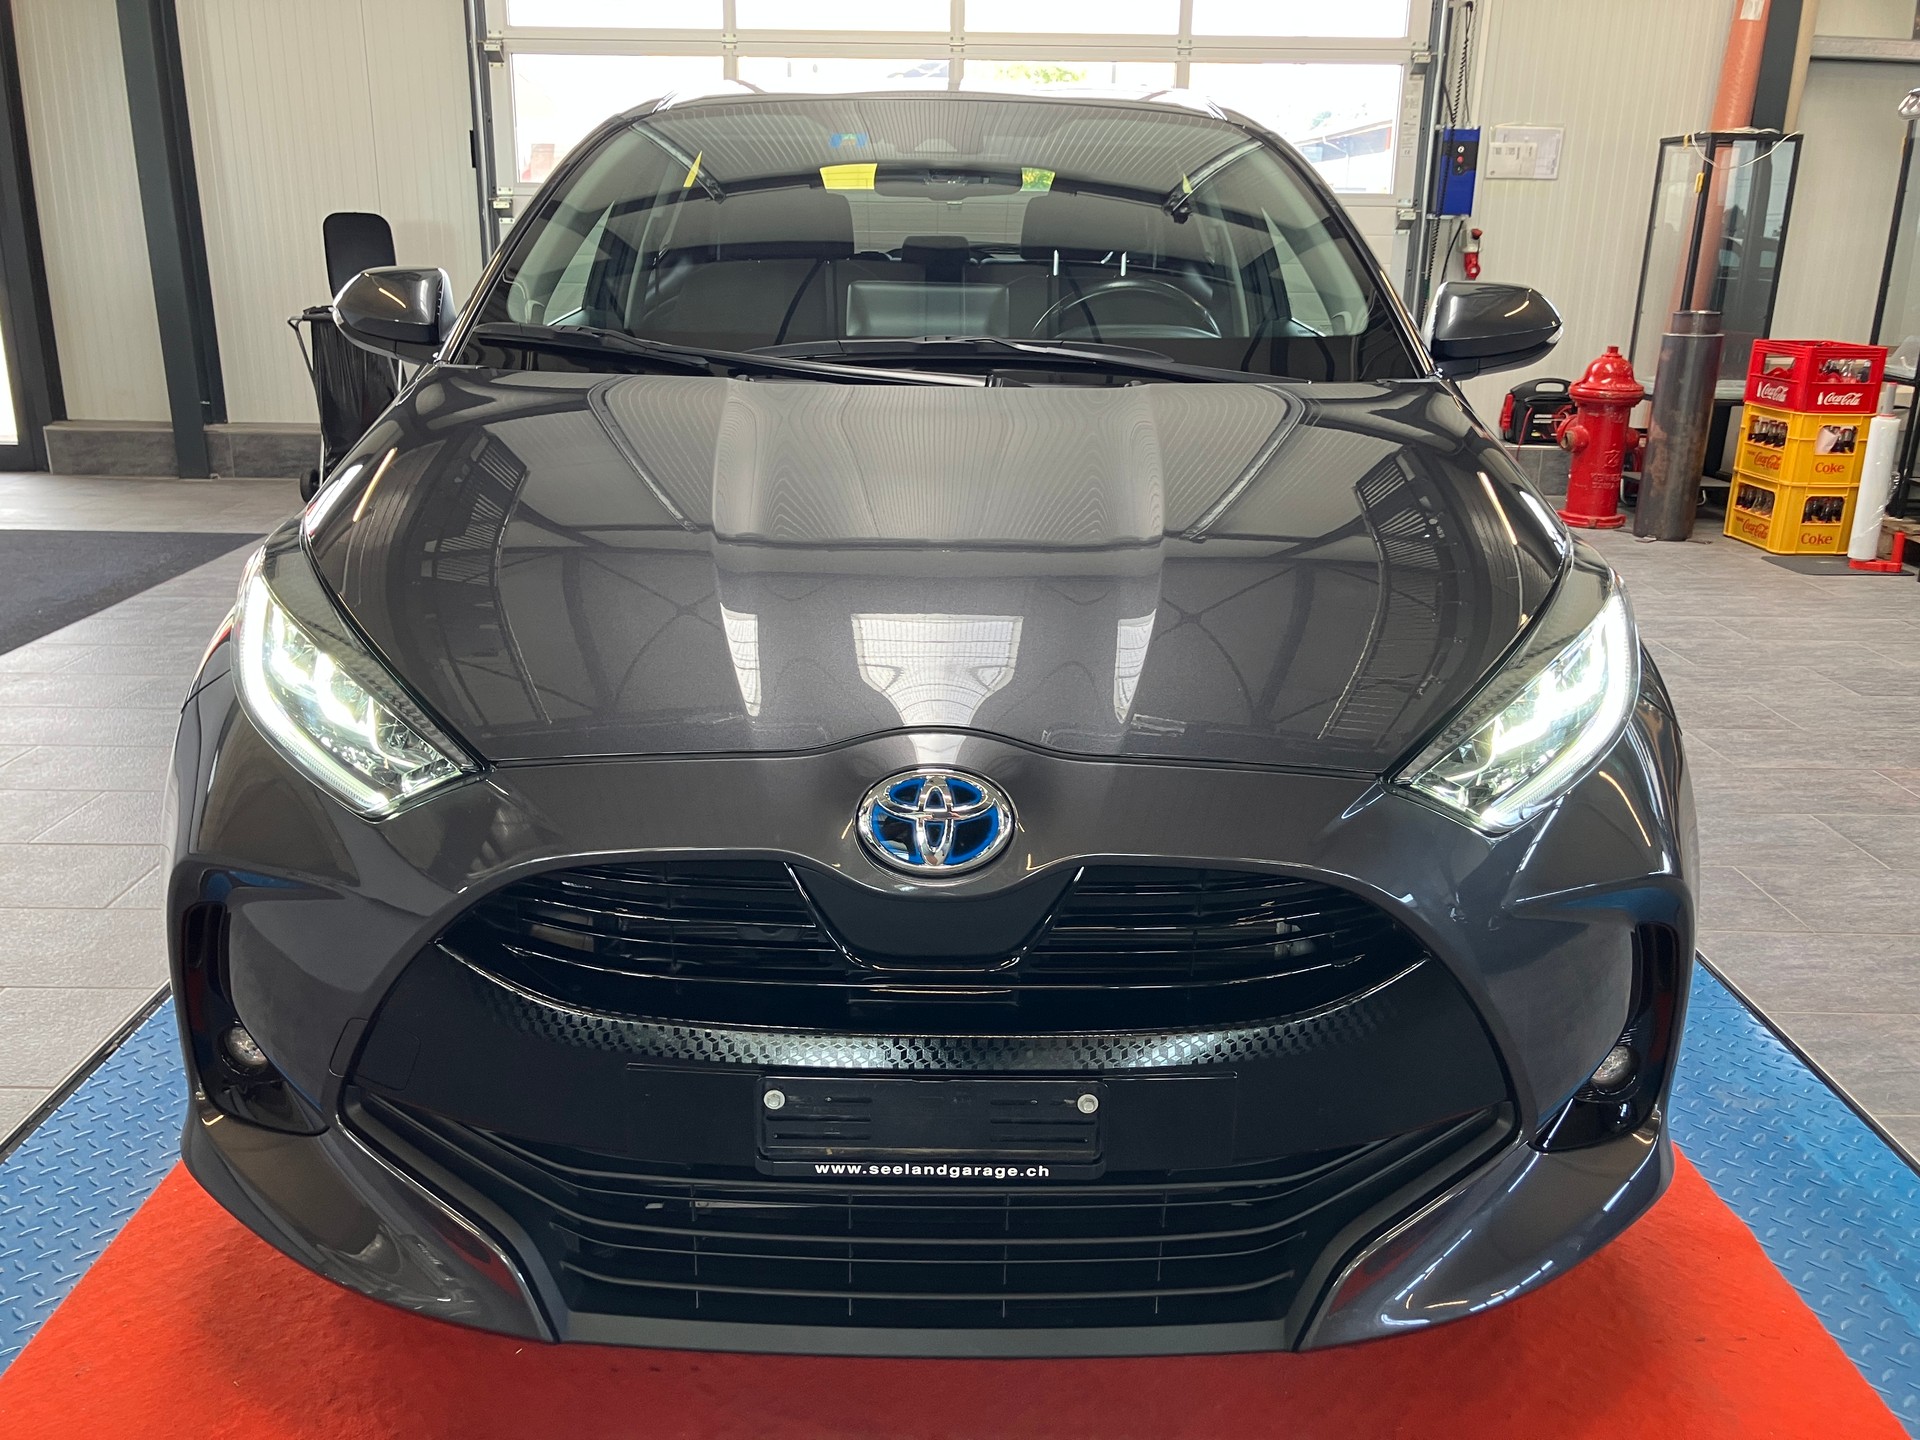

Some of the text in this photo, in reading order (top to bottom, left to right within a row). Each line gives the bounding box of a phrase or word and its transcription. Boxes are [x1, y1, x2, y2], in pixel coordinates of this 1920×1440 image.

[1815, 462, 1845, 473] Coke
[1800, 533, 1833, 545] Coke
[815, 1163, 1049, 1178] www.seelandgarage.ch
